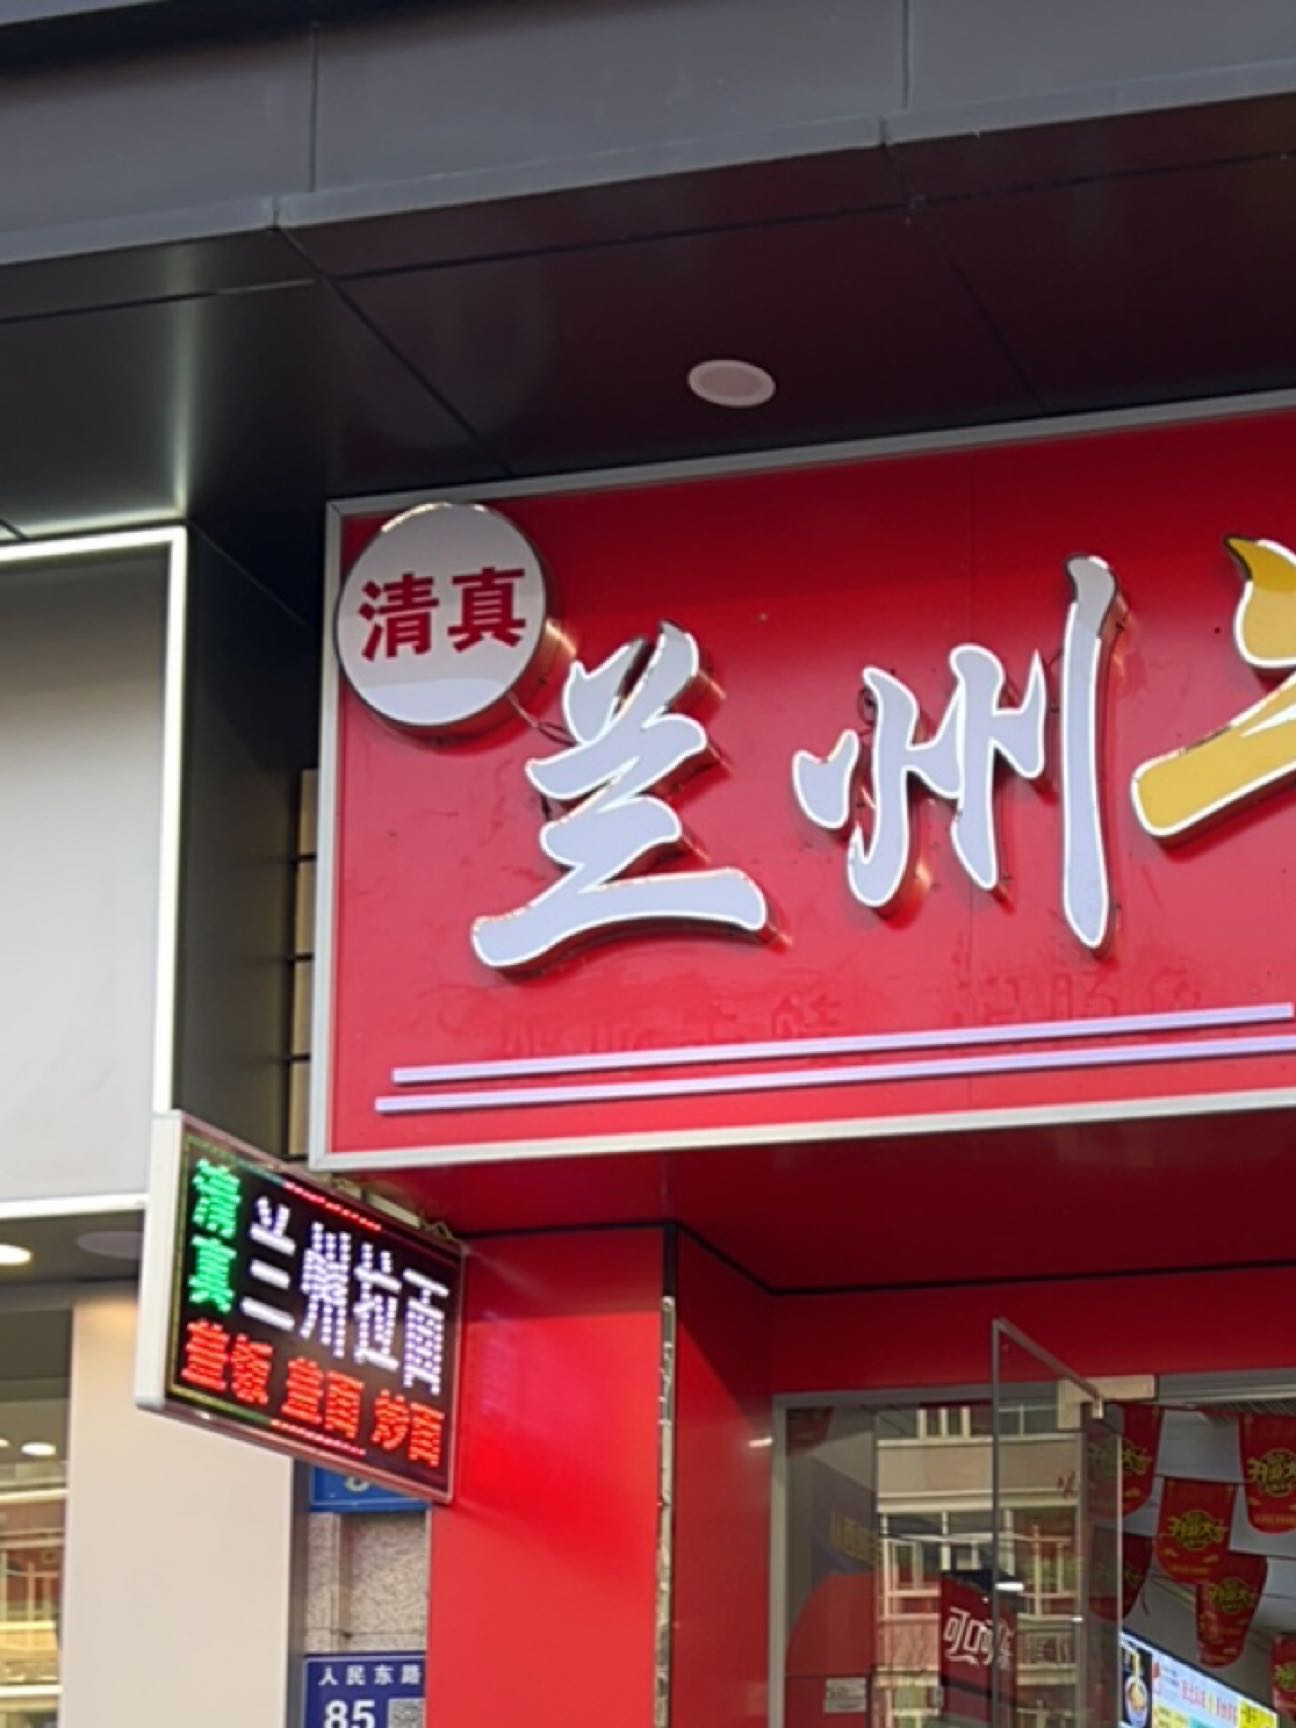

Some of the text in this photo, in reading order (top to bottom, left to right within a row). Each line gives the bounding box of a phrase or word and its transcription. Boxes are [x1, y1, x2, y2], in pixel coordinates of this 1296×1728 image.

[357, 566, 527, 663] 清真
[187, 1158, 241, 1314] 清真
[241, 1195, 450, 1397] 兰州拉面
[318, 1663, 422, 1687] 人民东路
